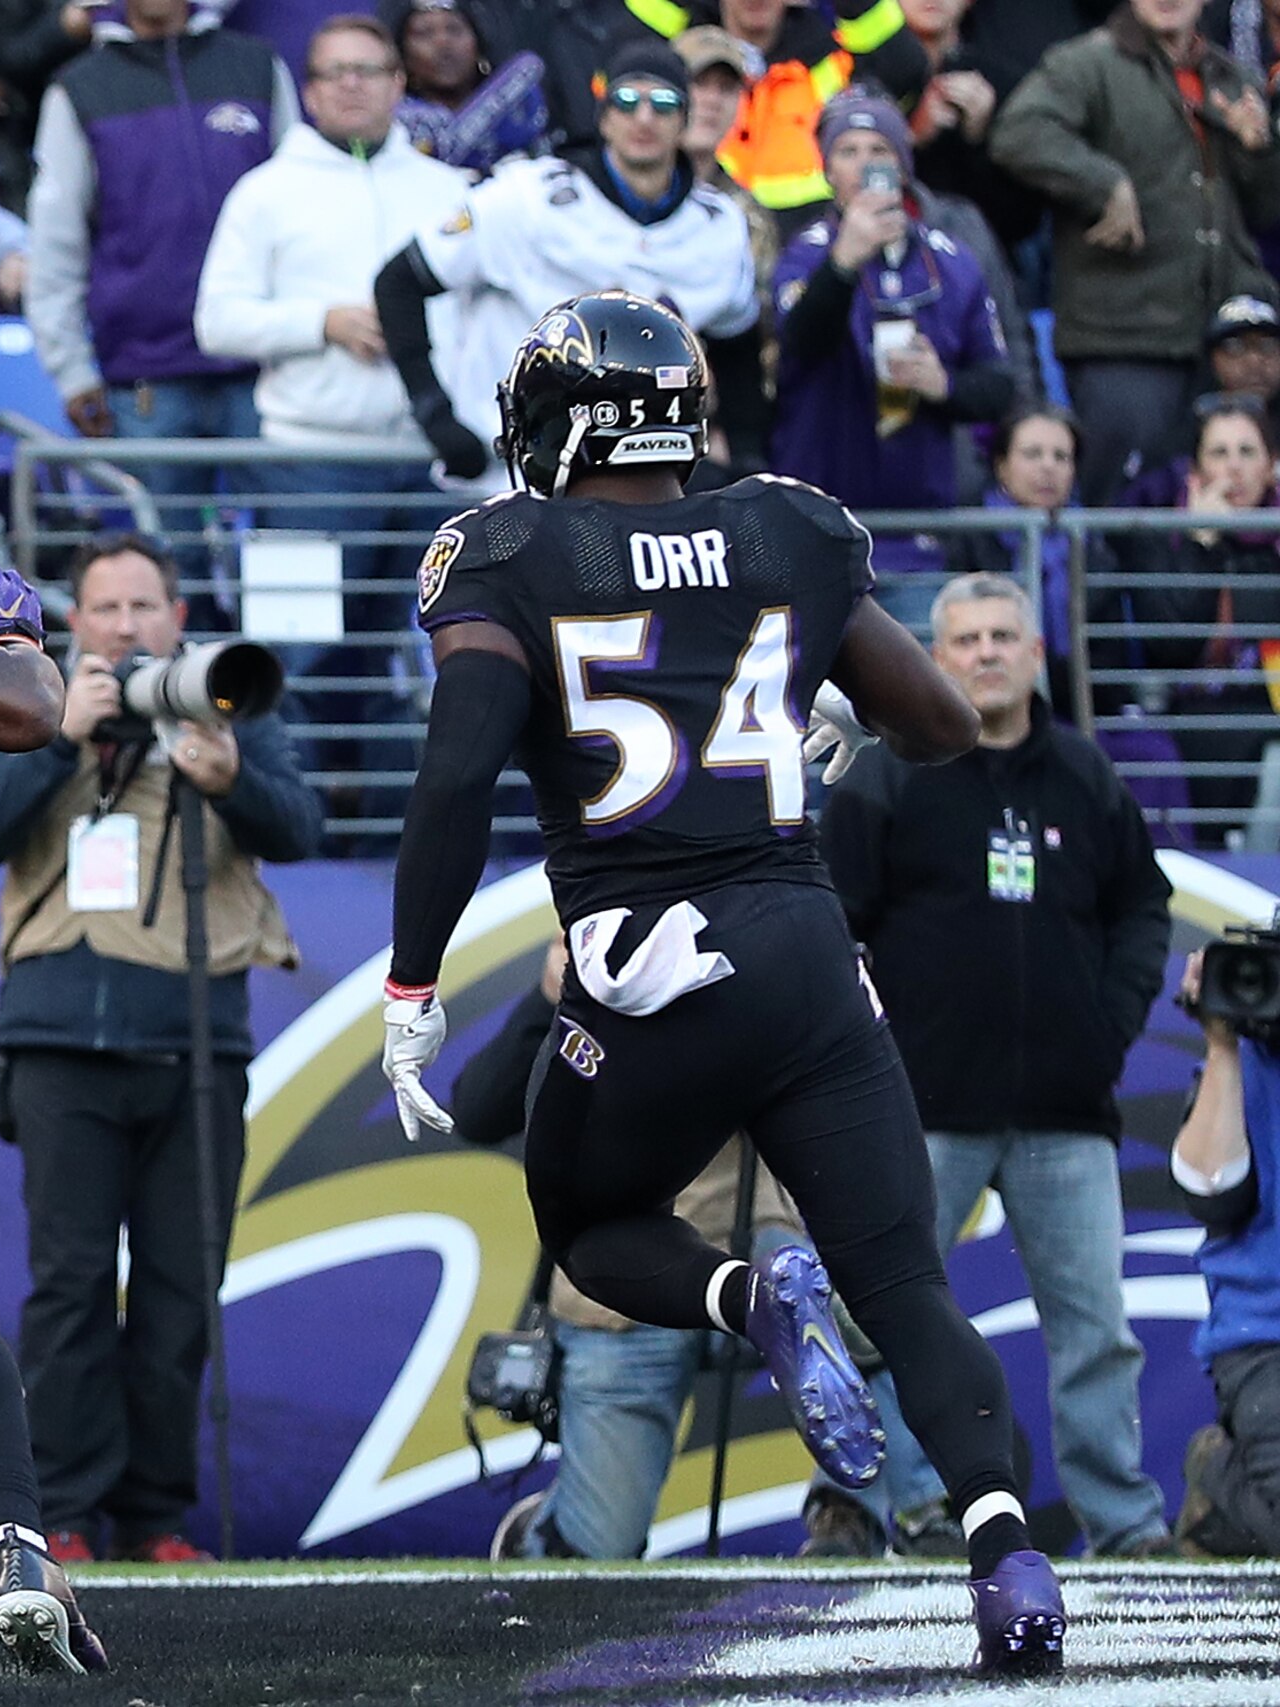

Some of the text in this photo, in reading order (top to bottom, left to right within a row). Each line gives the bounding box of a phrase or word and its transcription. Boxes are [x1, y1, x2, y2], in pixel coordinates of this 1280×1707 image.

[596, 405, 615, 423] CB
[622, 438, 689, 452] RAVENS
[629, 529, 730, 590] ORR
[550, 605, 806, 834] 54
